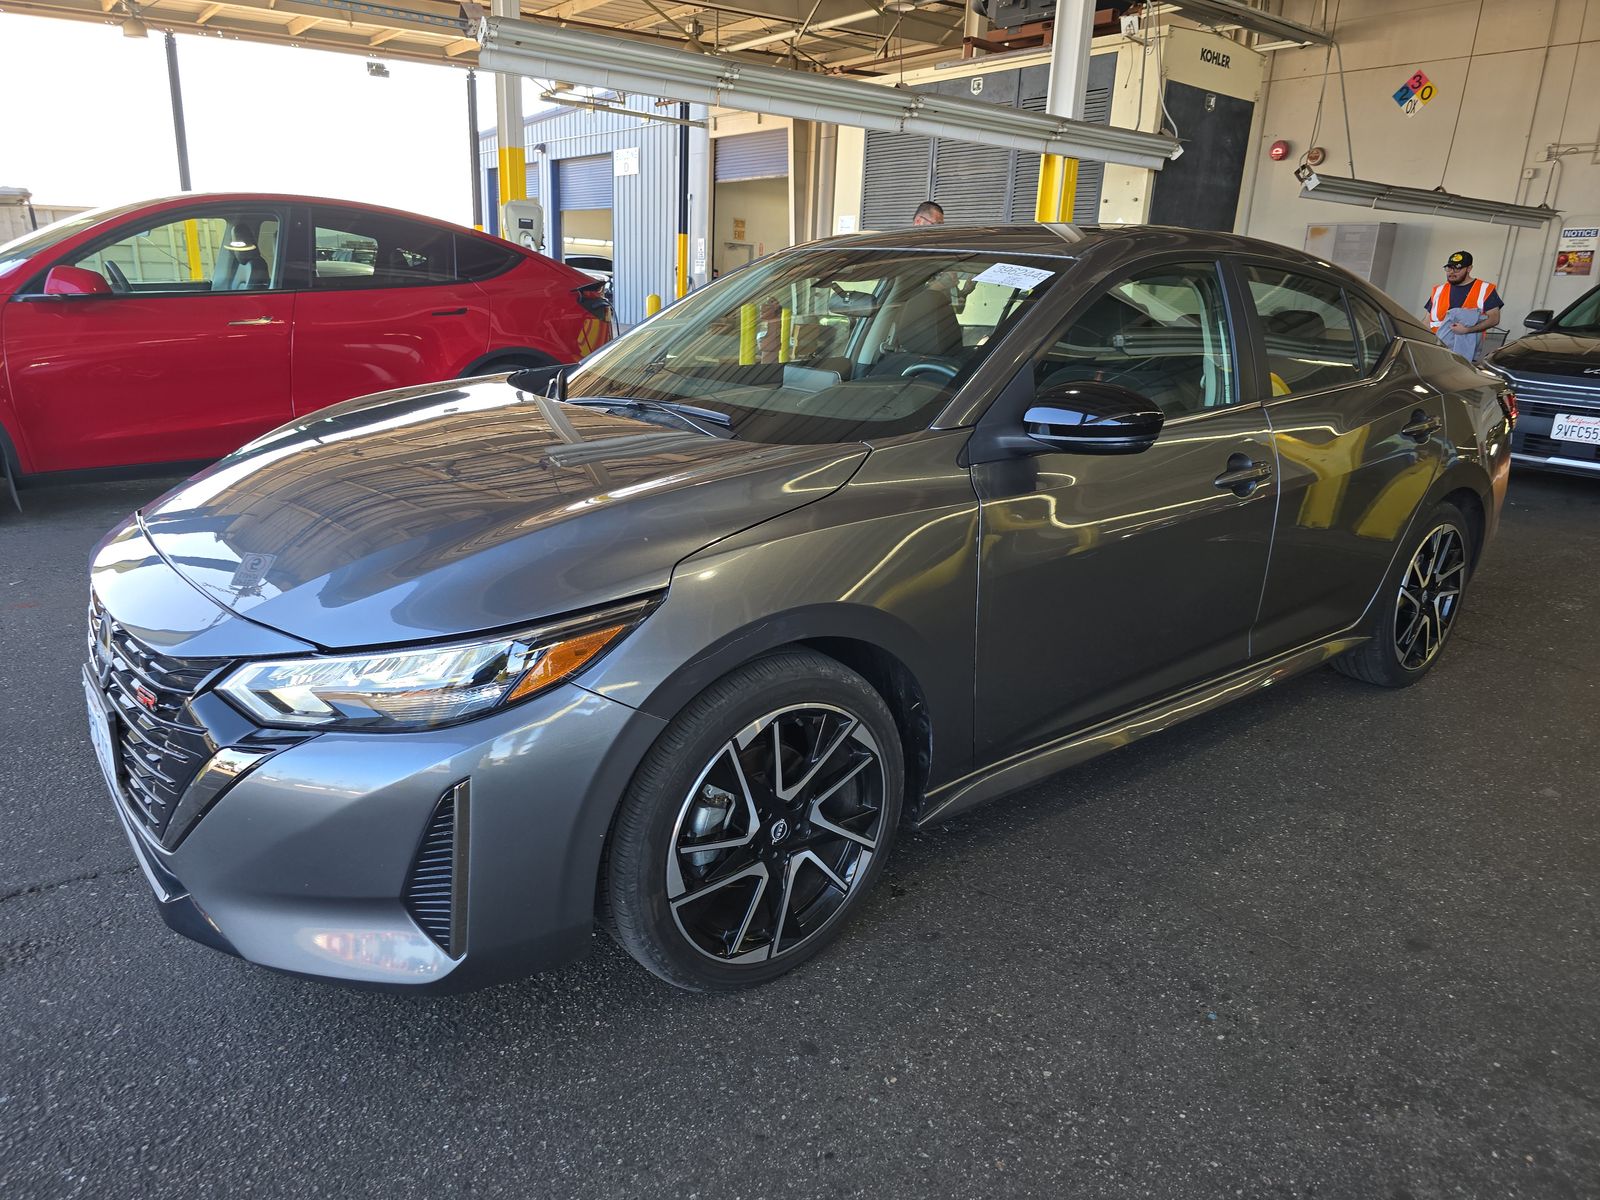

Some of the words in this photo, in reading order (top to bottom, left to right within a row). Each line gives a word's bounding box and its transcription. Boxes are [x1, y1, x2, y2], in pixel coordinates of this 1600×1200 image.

[1200, 48, 1231, 68] KOHLER
[1411, 74, 1422, 89] 3
[1399, 86, 1409, 101] 2
[1420, 86, 1433, 101] 0
[1555, 423, 1600, 440] 9VFC55
